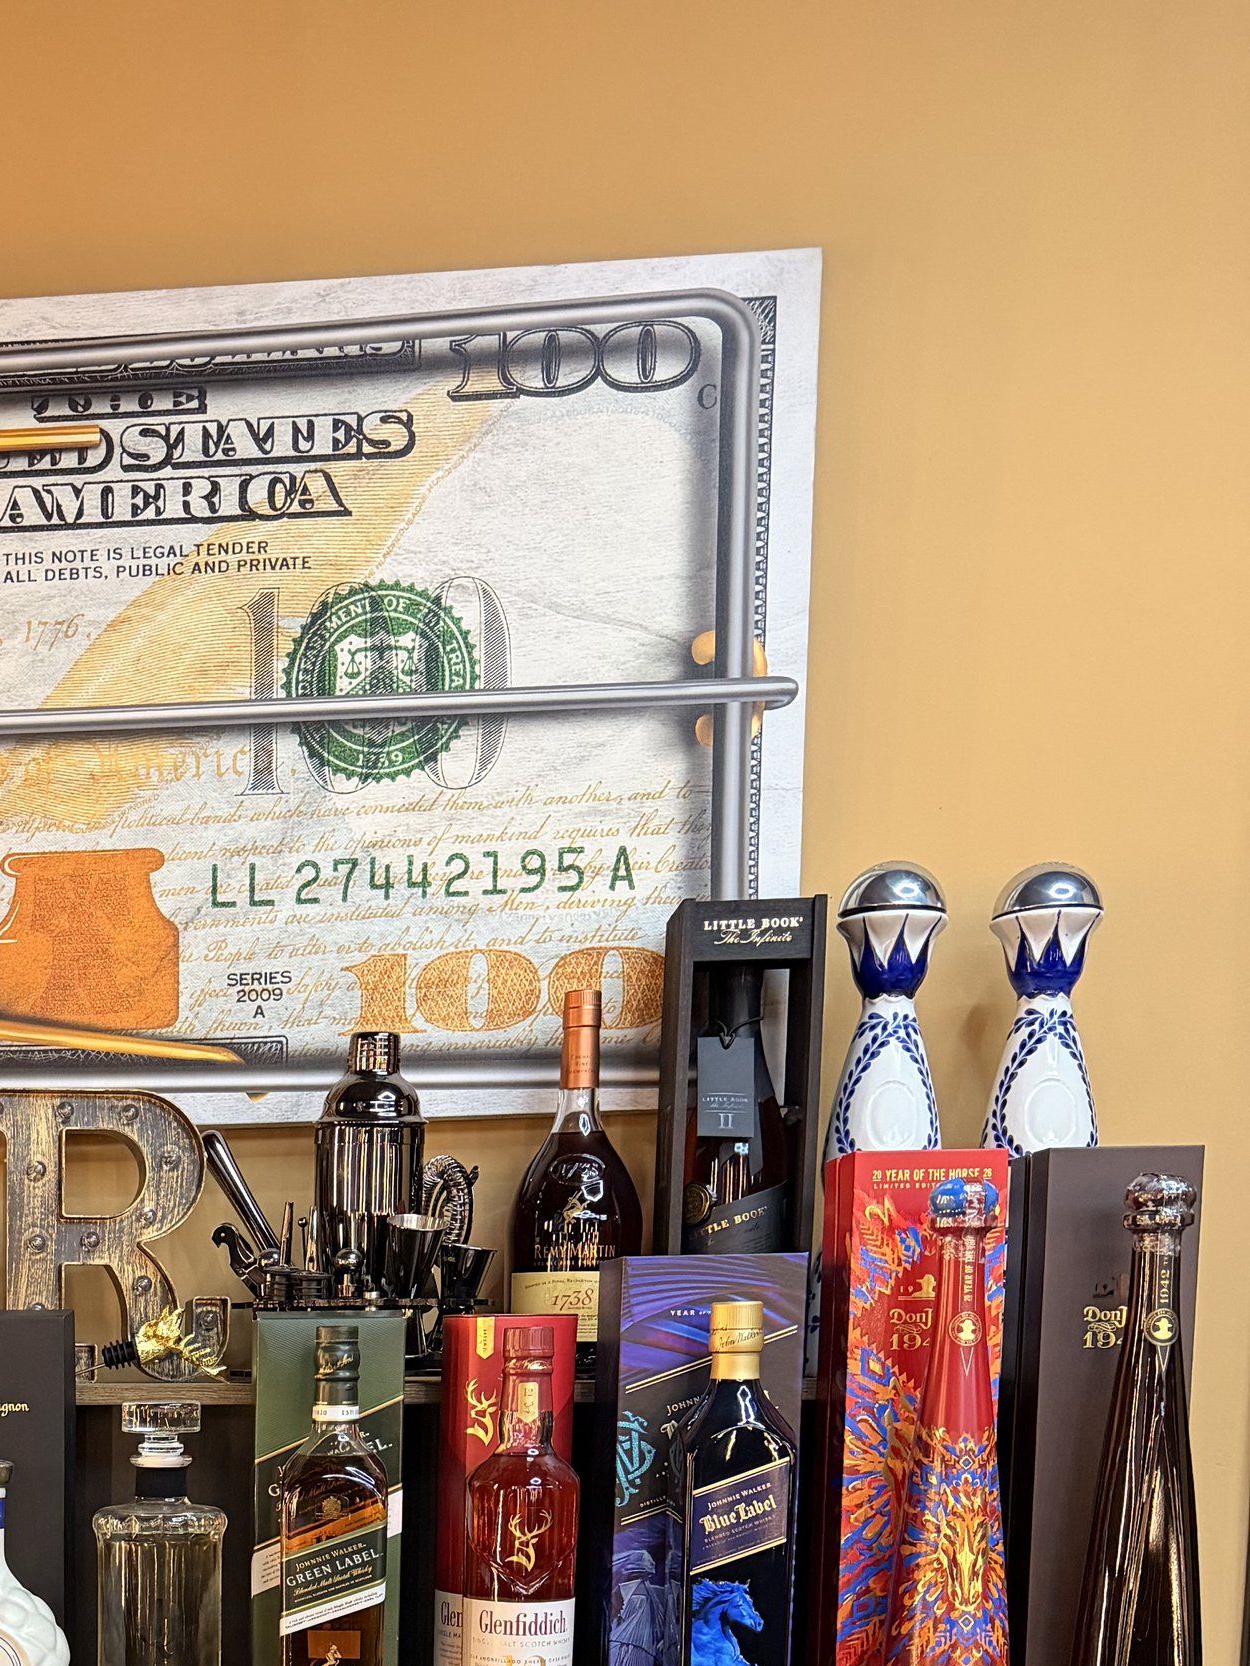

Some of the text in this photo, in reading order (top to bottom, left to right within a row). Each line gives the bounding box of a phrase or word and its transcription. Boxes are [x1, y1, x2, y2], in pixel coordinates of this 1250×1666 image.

[447, 319, 701, 402] 100
[119, 409, 416, 475] STATES
[2, 540, 270, 567] THIS NOTE IS LEGAL TENDER
[3, 554, 313, 584] ALL DEBTS, PUBLIC AND PRIVATE
[210, 845, 636, 909] LL 27442195 A
[703, 918, 756, 931] LITTLE
[713, 928, 793, 947] The Infinite
[226, 970, 293, 988] SERIES
[236, 988, 284, 1003] 2009
[252, 1004, 267, 1019] A
[885, 1167, 980, 1182] YEAR OF THE HORSE
[551, 1287, 594, 1312] 1738
[669, 1308, 696, 1317] YEAR
[707, 1480, 772, 1511] JOHNNIE WALKER
[699, 1493, 778, 1535] Blue Label
[285, 1547, 384, 1588] GREEN LABEL
[295, 1542, 367, 1572] JOHNNIE WALKER
[519, 1640, 551, 1648] SCOTCH
